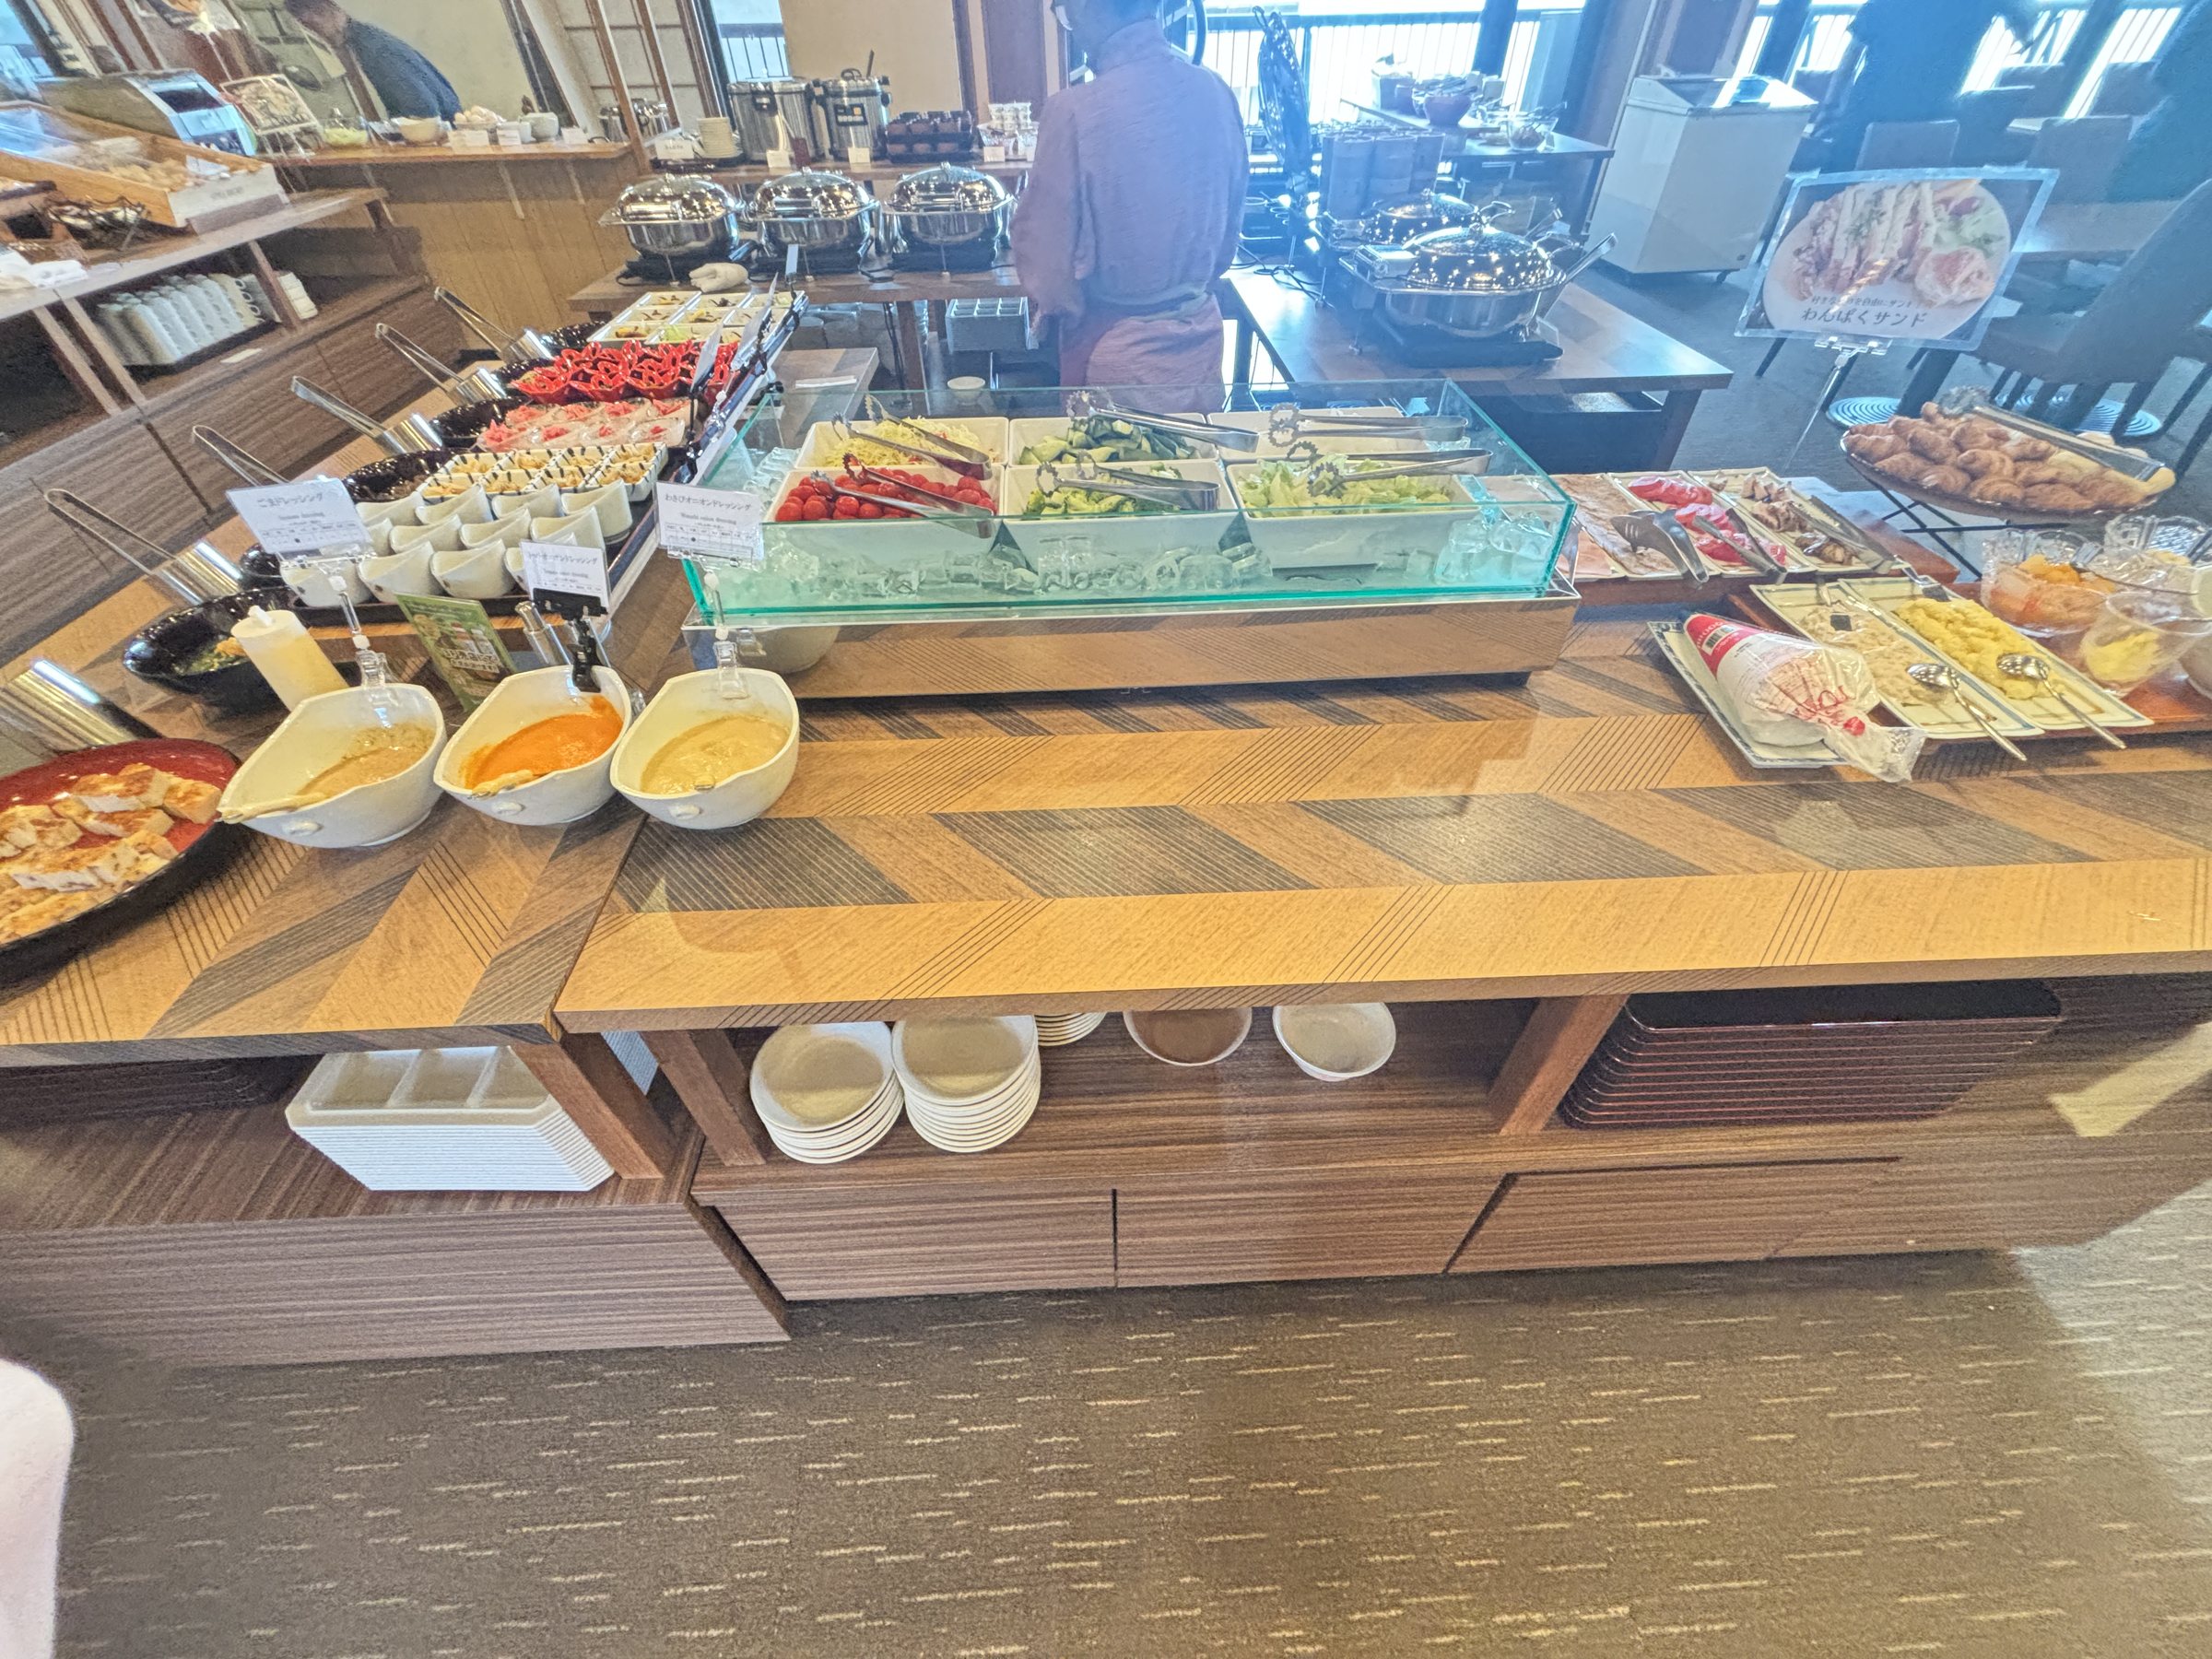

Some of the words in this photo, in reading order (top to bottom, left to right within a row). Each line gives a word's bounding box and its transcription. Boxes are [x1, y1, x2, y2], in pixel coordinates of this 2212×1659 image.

[1801, 307, 1928, 328] わんぱくサンド
[665, 493, 752, 511] わさびオニオンドレッシング
